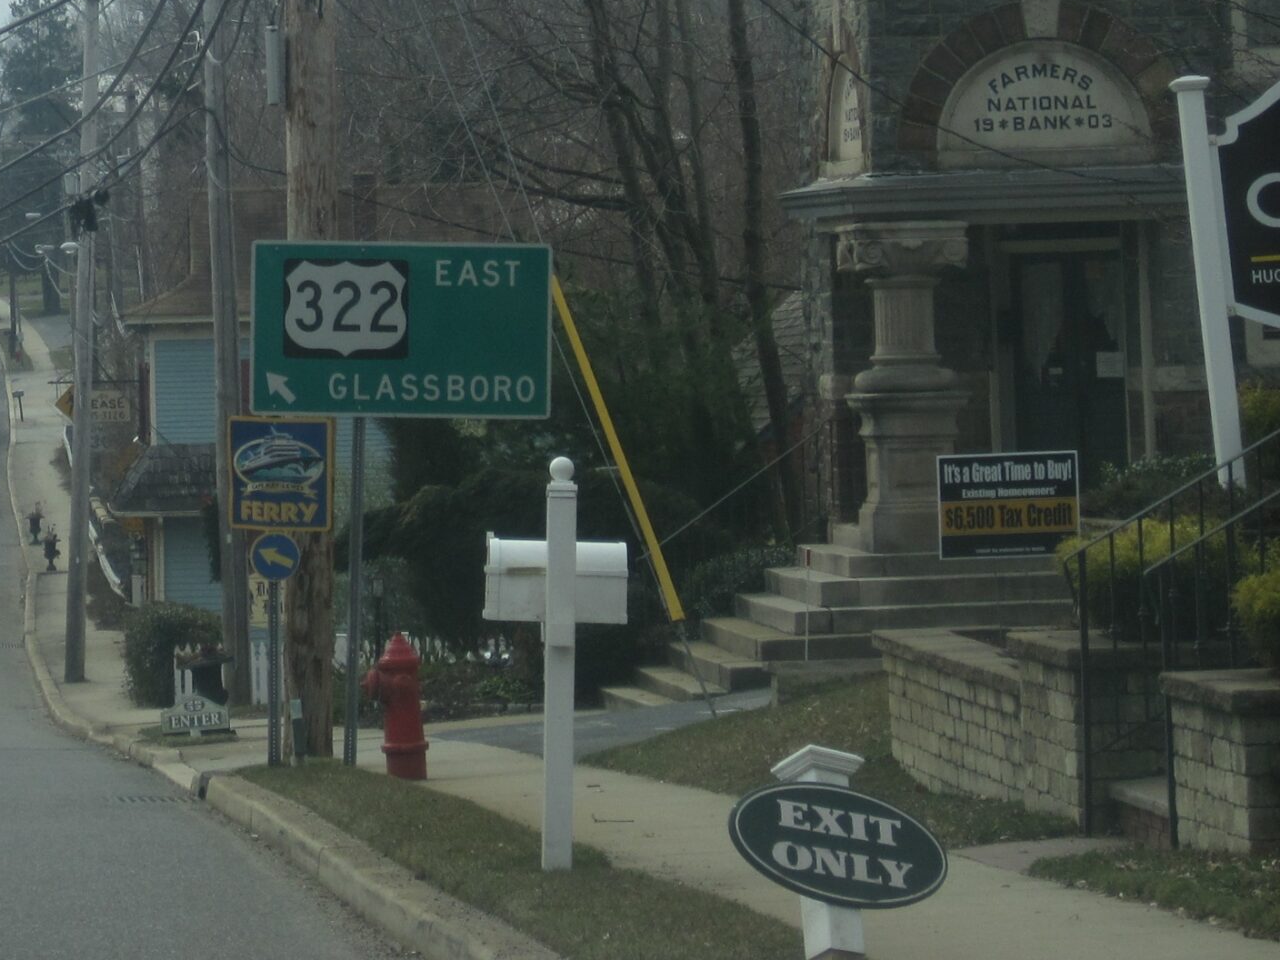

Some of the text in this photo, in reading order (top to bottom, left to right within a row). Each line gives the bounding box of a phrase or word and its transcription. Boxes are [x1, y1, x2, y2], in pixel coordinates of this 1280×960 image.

[988, 63, 1093, 95] FARMERS
[987, 94, 1097, 112] NATIONAL
[974, 114, 1113, 132] 19 BANK 03
[435, 259, 521, 287] EAST
[294, 279, 399, 333] 322
[328, 372, 536, 403] GLASSBORO
[91, 398, 126, 409] EASE
[943, 459, 1072, 485] It's a Great Time to Buy!
[962, 487, 996, 499] Existing
[240, 500, 319, 524] FERRY
[997, 504, 1023, 528] Tax
[1026, 502, 1073, 527] Credit
[170, 712, 221, 729] ENTER
[776, 799, 902, 846] EXIT
[771, 840, 913, 889] ONLY
